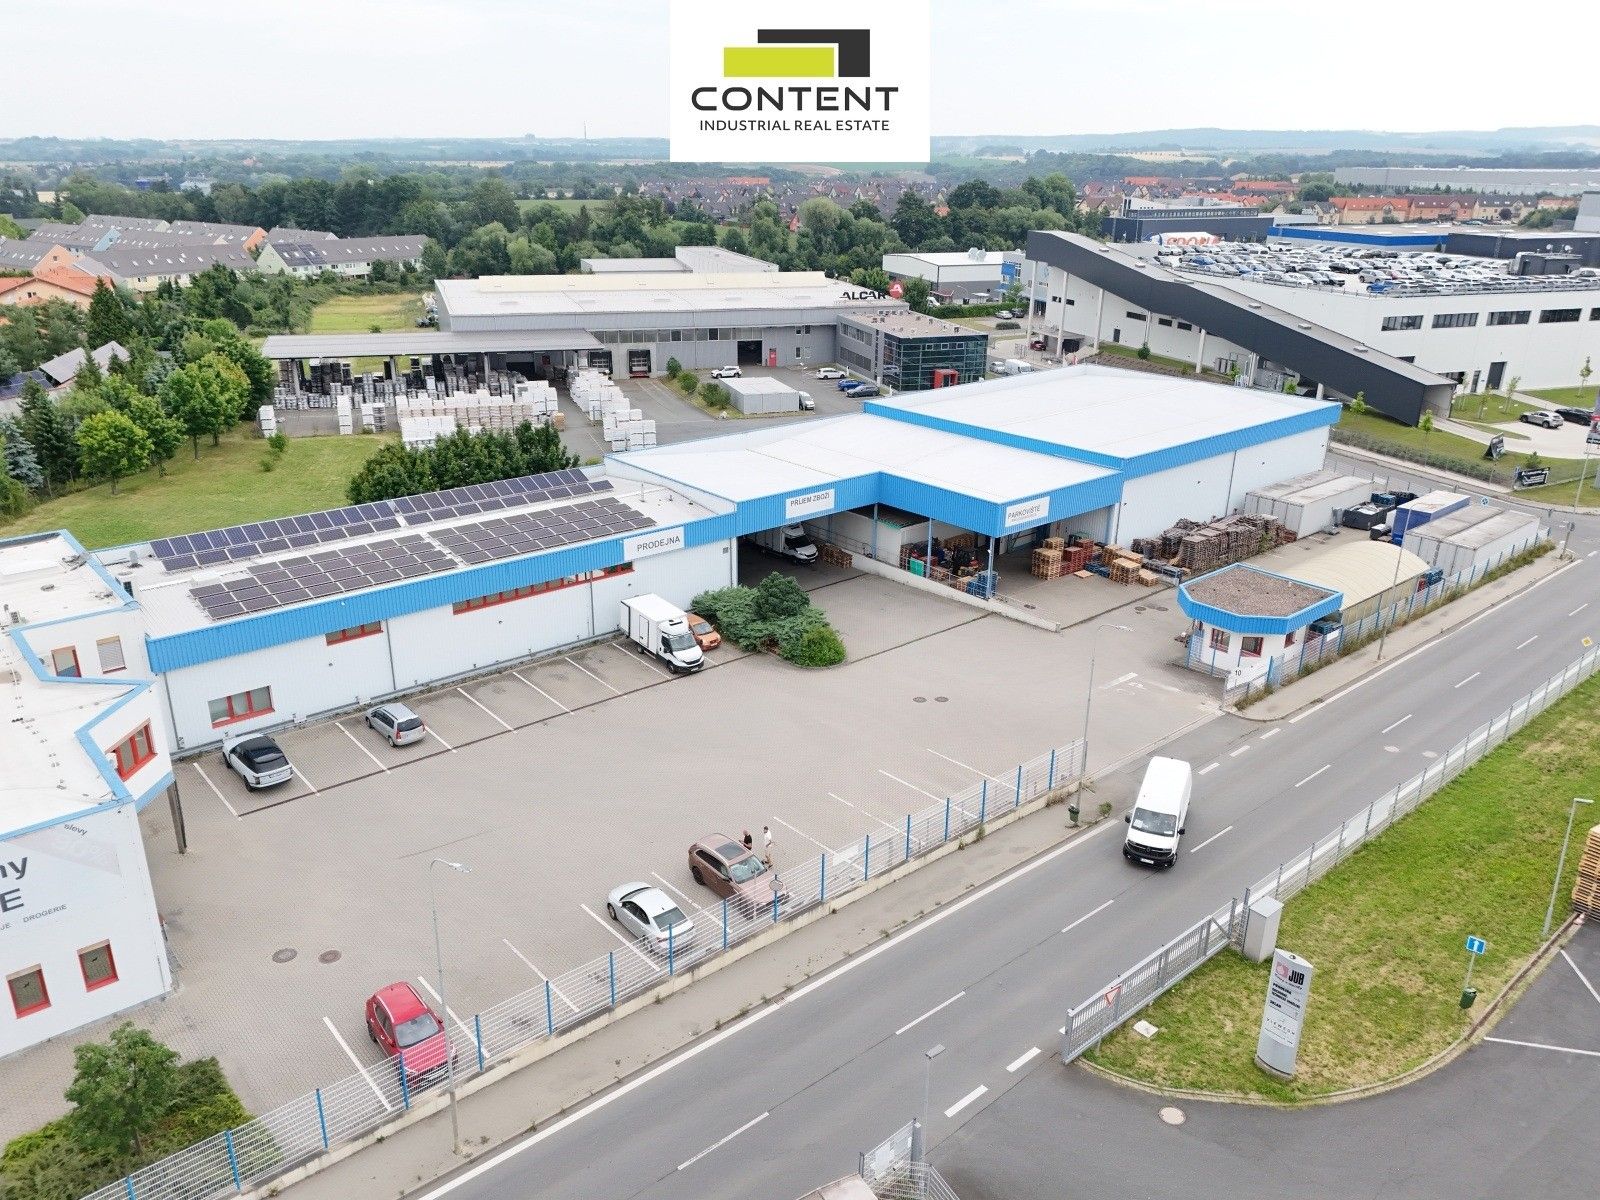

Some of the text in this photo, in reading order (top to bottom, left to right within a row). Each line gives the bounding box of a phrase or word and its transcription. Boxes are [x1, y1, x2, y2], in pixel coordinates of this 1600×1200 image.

[839, 291, 886, 300] ALCAR
[637, 535, 681, 551] PRODEJNA
[23, 904, 67, 923] DROGERIE
[1289, 970, 1305, 985] JUB
